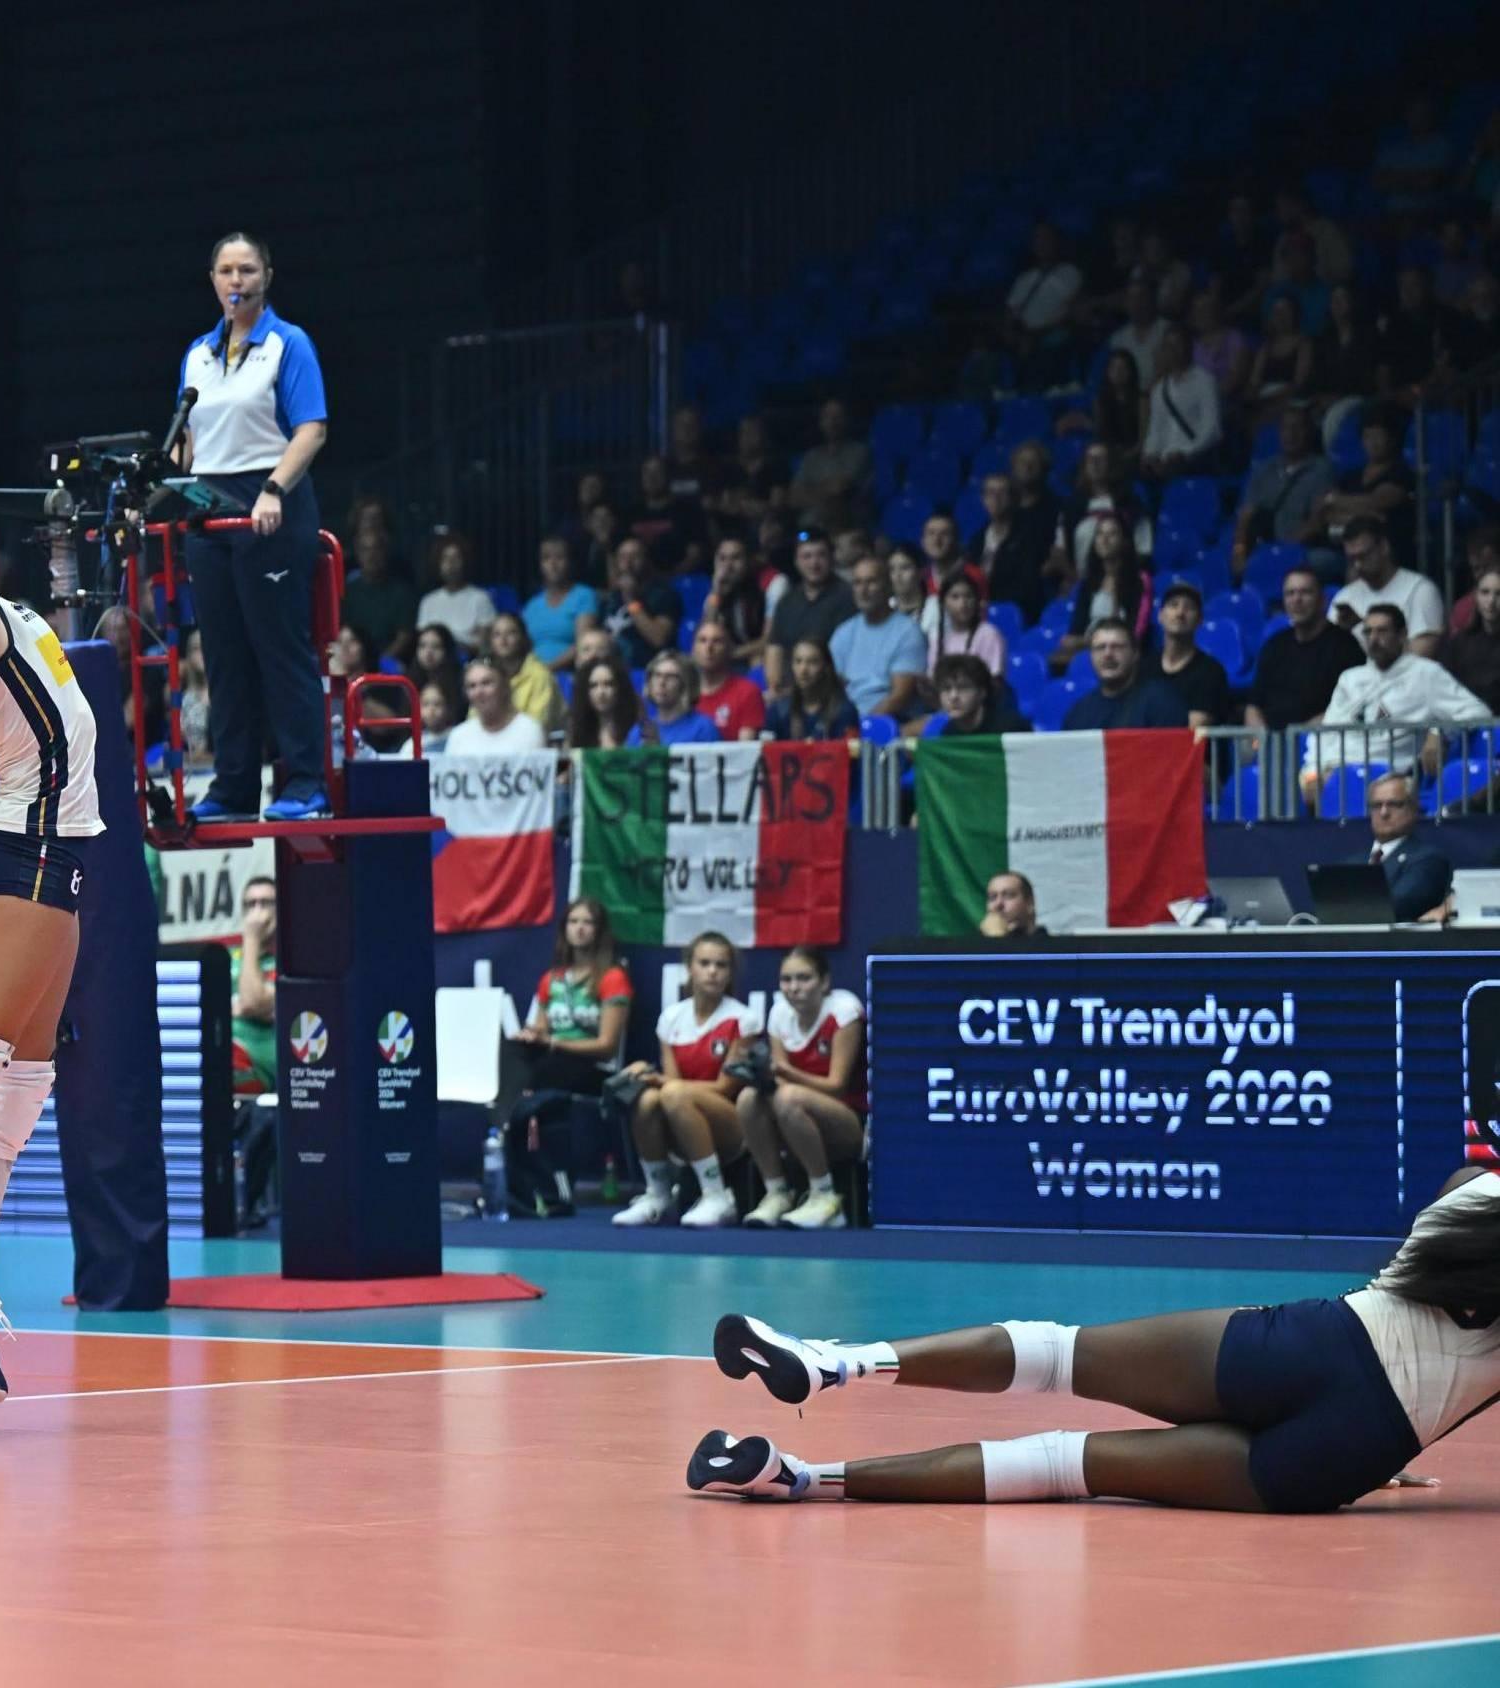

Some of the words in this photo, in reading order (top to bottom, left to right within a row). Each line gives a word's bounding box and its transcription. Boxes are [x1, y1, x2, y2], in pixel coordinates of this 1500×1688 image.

[161, 854, 234, 924] LNÁ
[959, 999, 1059, 1045] CEV
[1070, 992, 1294, 1064] Trendyol
[927, 1068, 1188, 1133] EuroVolley
[1206, 1070, 1332, 1126] 2026
[1029, 1141, 1220, 1199] Women
